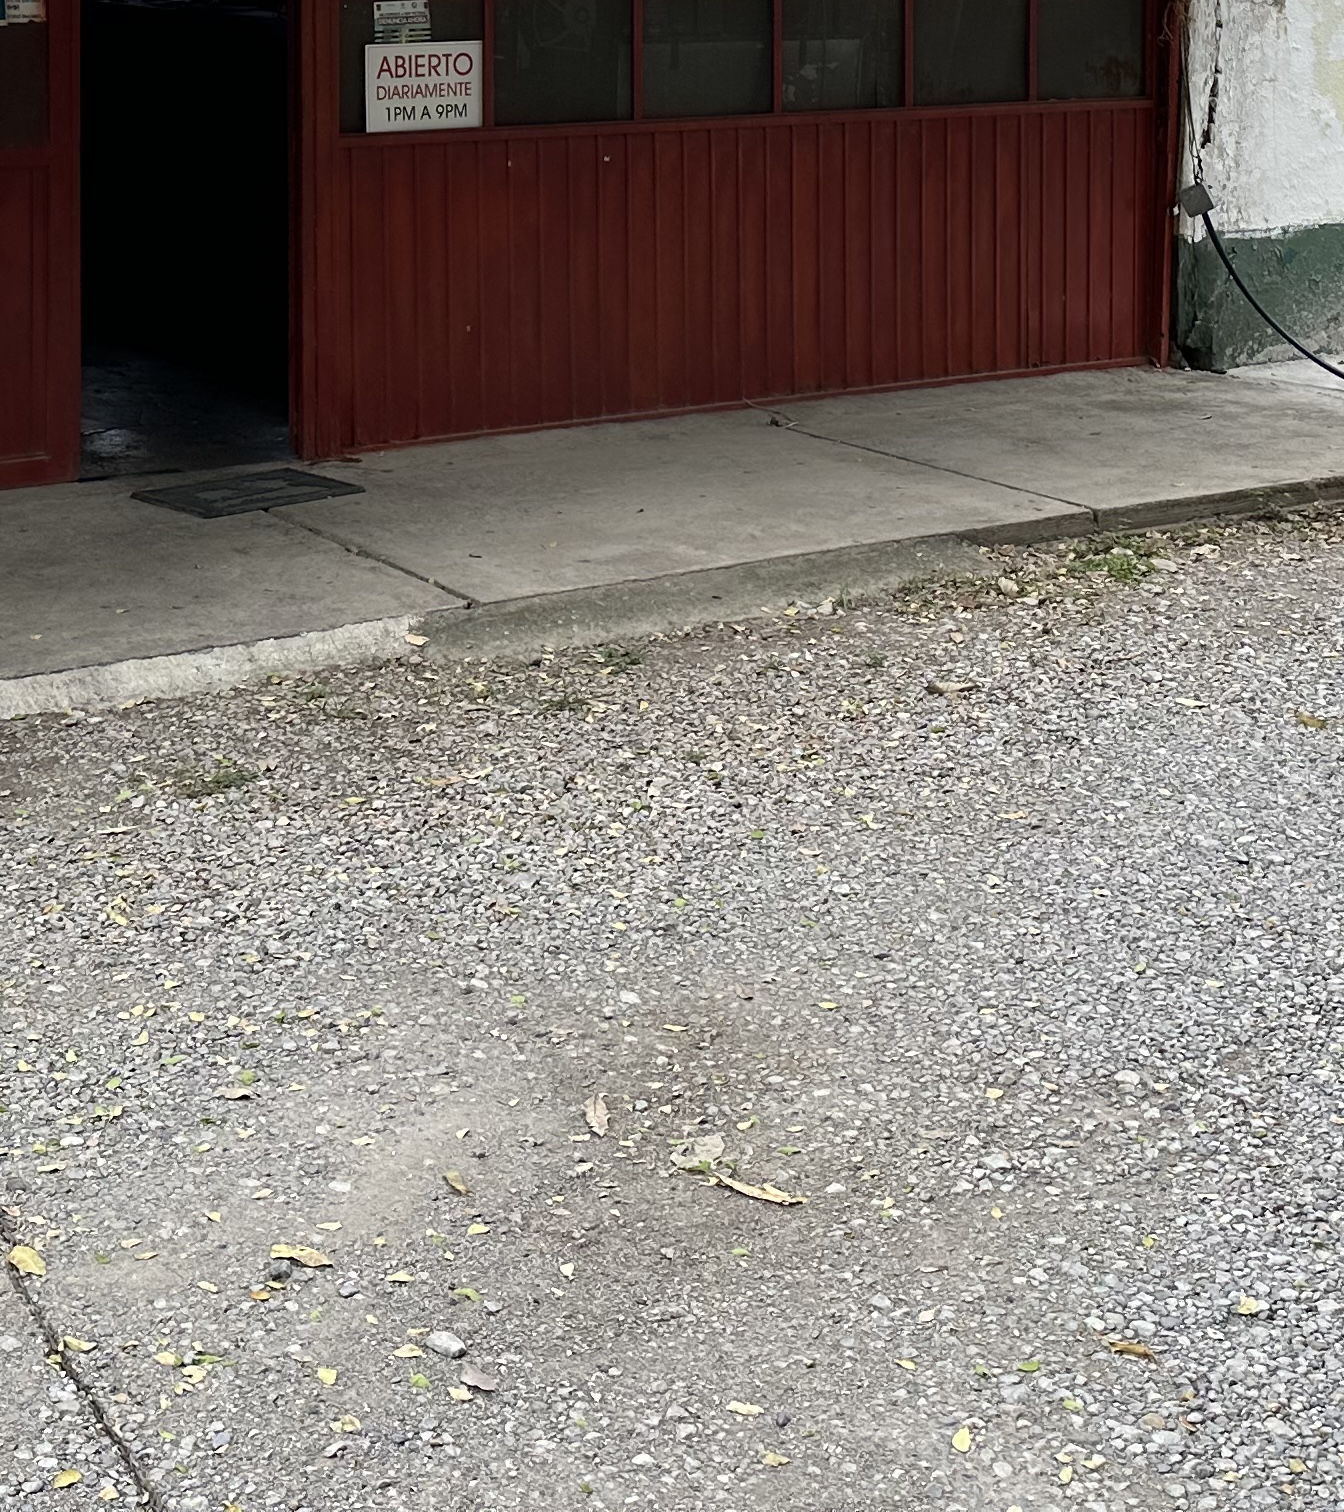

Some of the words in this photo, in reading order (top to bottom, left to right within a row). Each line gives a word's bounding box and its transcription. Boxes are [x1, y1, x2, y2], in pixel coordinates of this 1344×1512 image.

[376, 52, 473, 79] ABIERTO
[376, 82, 472, 101] DIARIAMENTE
[386, 105, 415, 122] 1PM
[420, 105, 432, 120] A
[436, 103, 467, 119] 9PM
